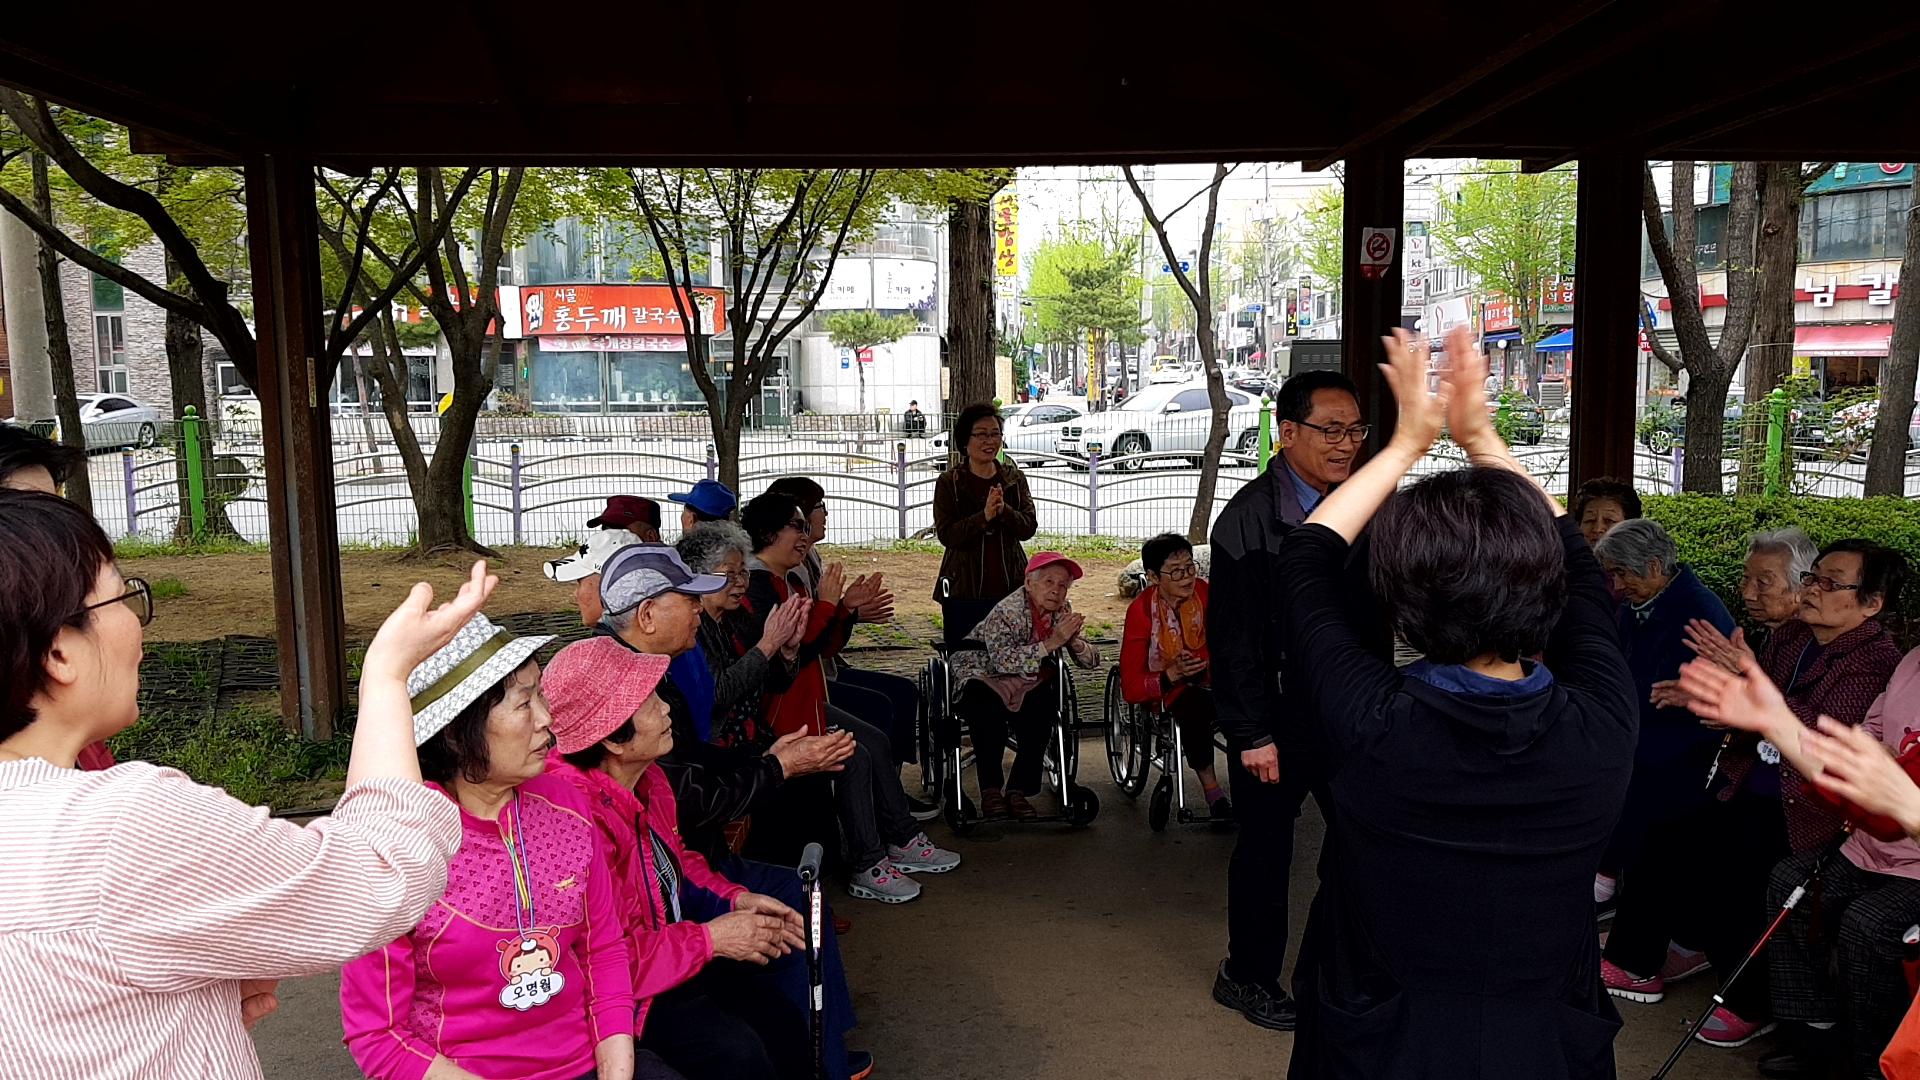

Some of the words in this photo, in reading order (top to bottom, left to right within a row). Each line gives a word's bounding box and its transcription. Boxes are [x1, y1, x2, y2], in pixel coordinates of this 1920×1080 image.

[553, 289, 577, 303] 시골
[552, 305, 626, 333] 홍두깨
[631, 306, 682, 325] 칼국수
[513, 977, 551, 1001] 오명월
